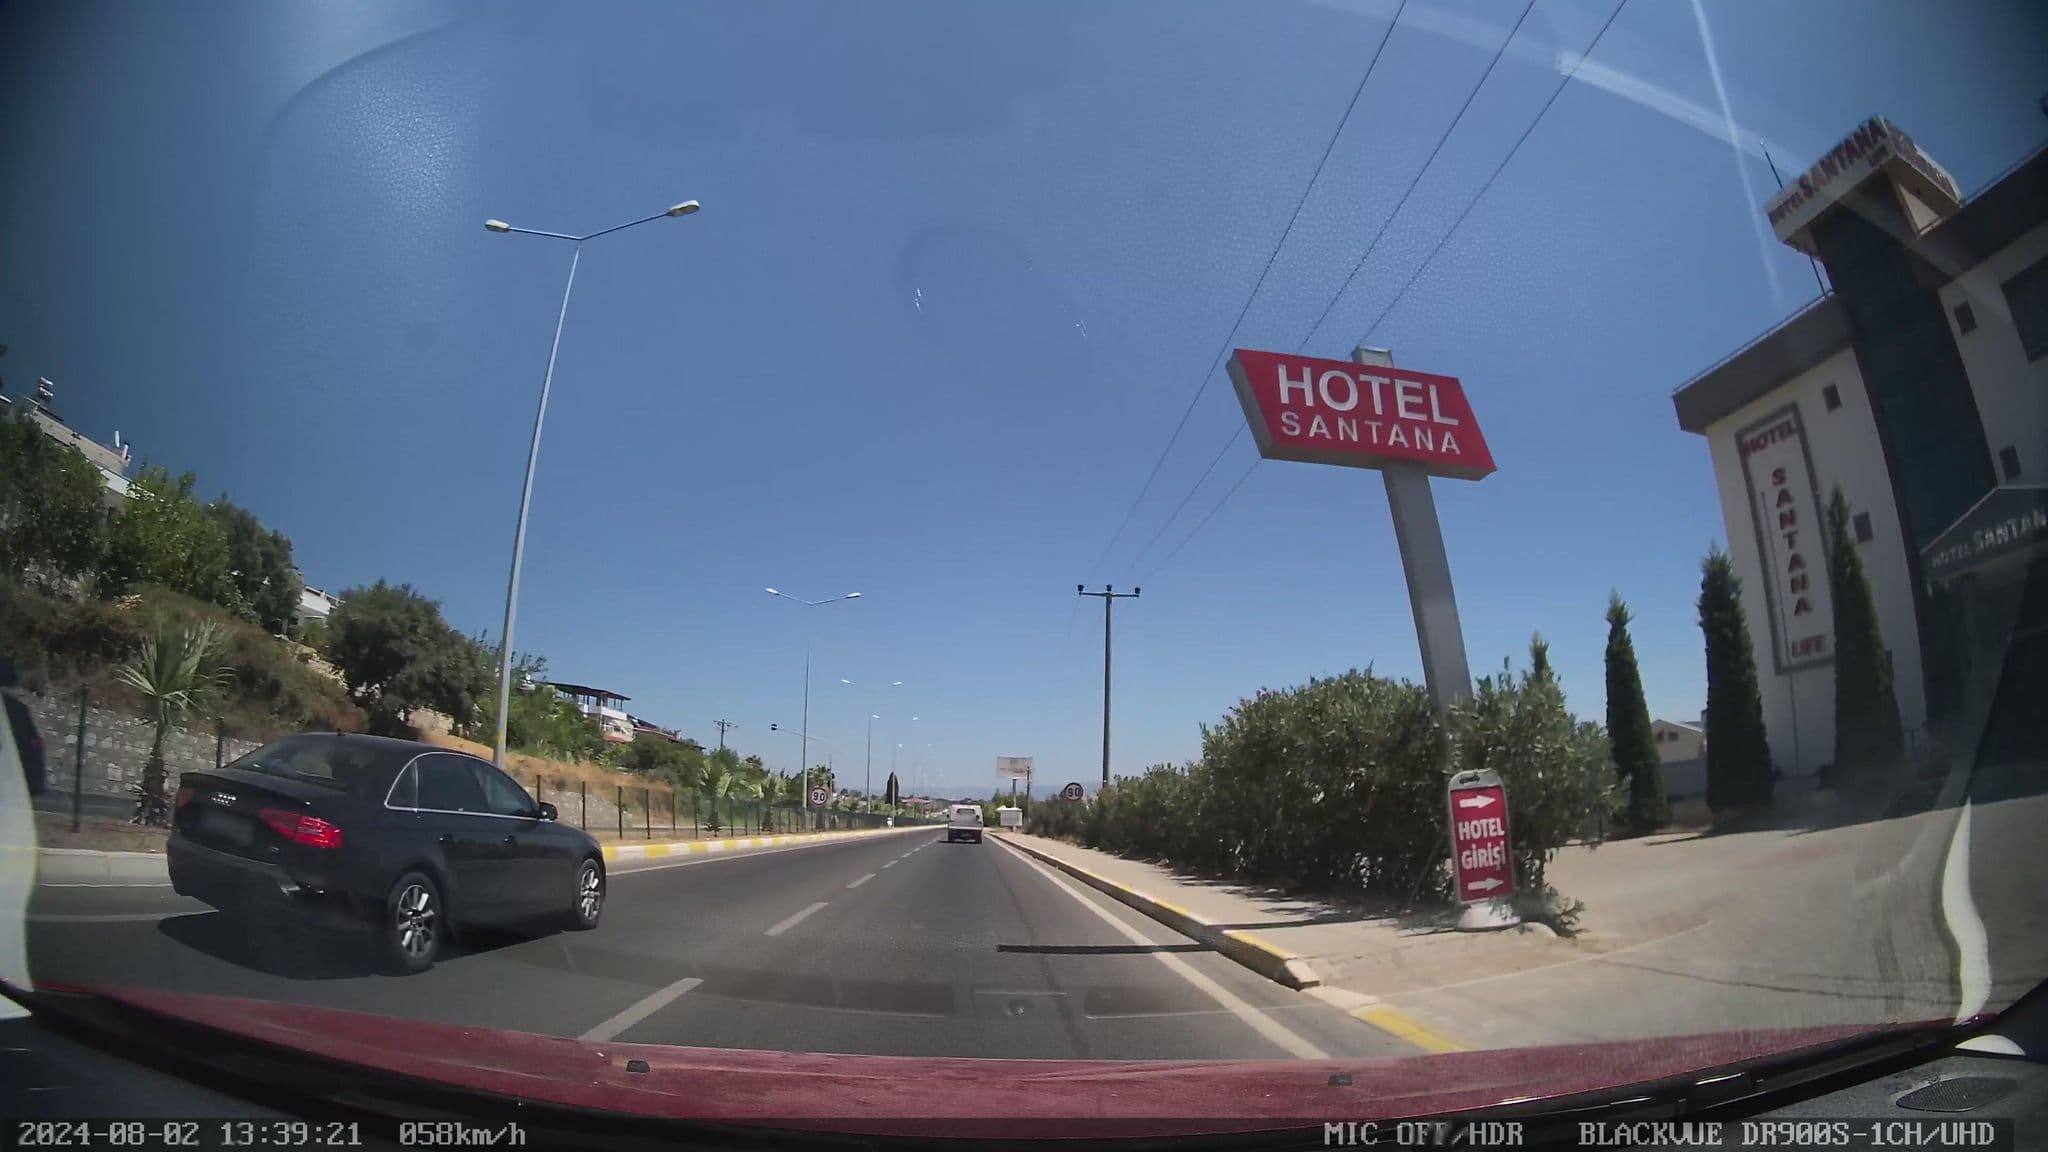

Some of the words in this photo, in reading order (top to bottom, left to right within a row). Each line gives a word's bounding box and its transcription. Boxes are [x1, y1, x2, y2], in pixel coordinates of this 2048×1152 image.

[1278, 363, 1459, 426] HOTEL
[1280, 411, 1461, 455] SANTANA
[1741, 421, 1796, 457] HOTEL
[1771, 466, 1813, 617] SANTANA
[1972, 505, 2048, 552] SANTAN
[814, 792, 825, 801] 90
[1068, 788, 1081, 797] 90
[1458, 817, 1505, 841] HOTEL
[1461, 841, 1506, 871] GİRİŞİ
